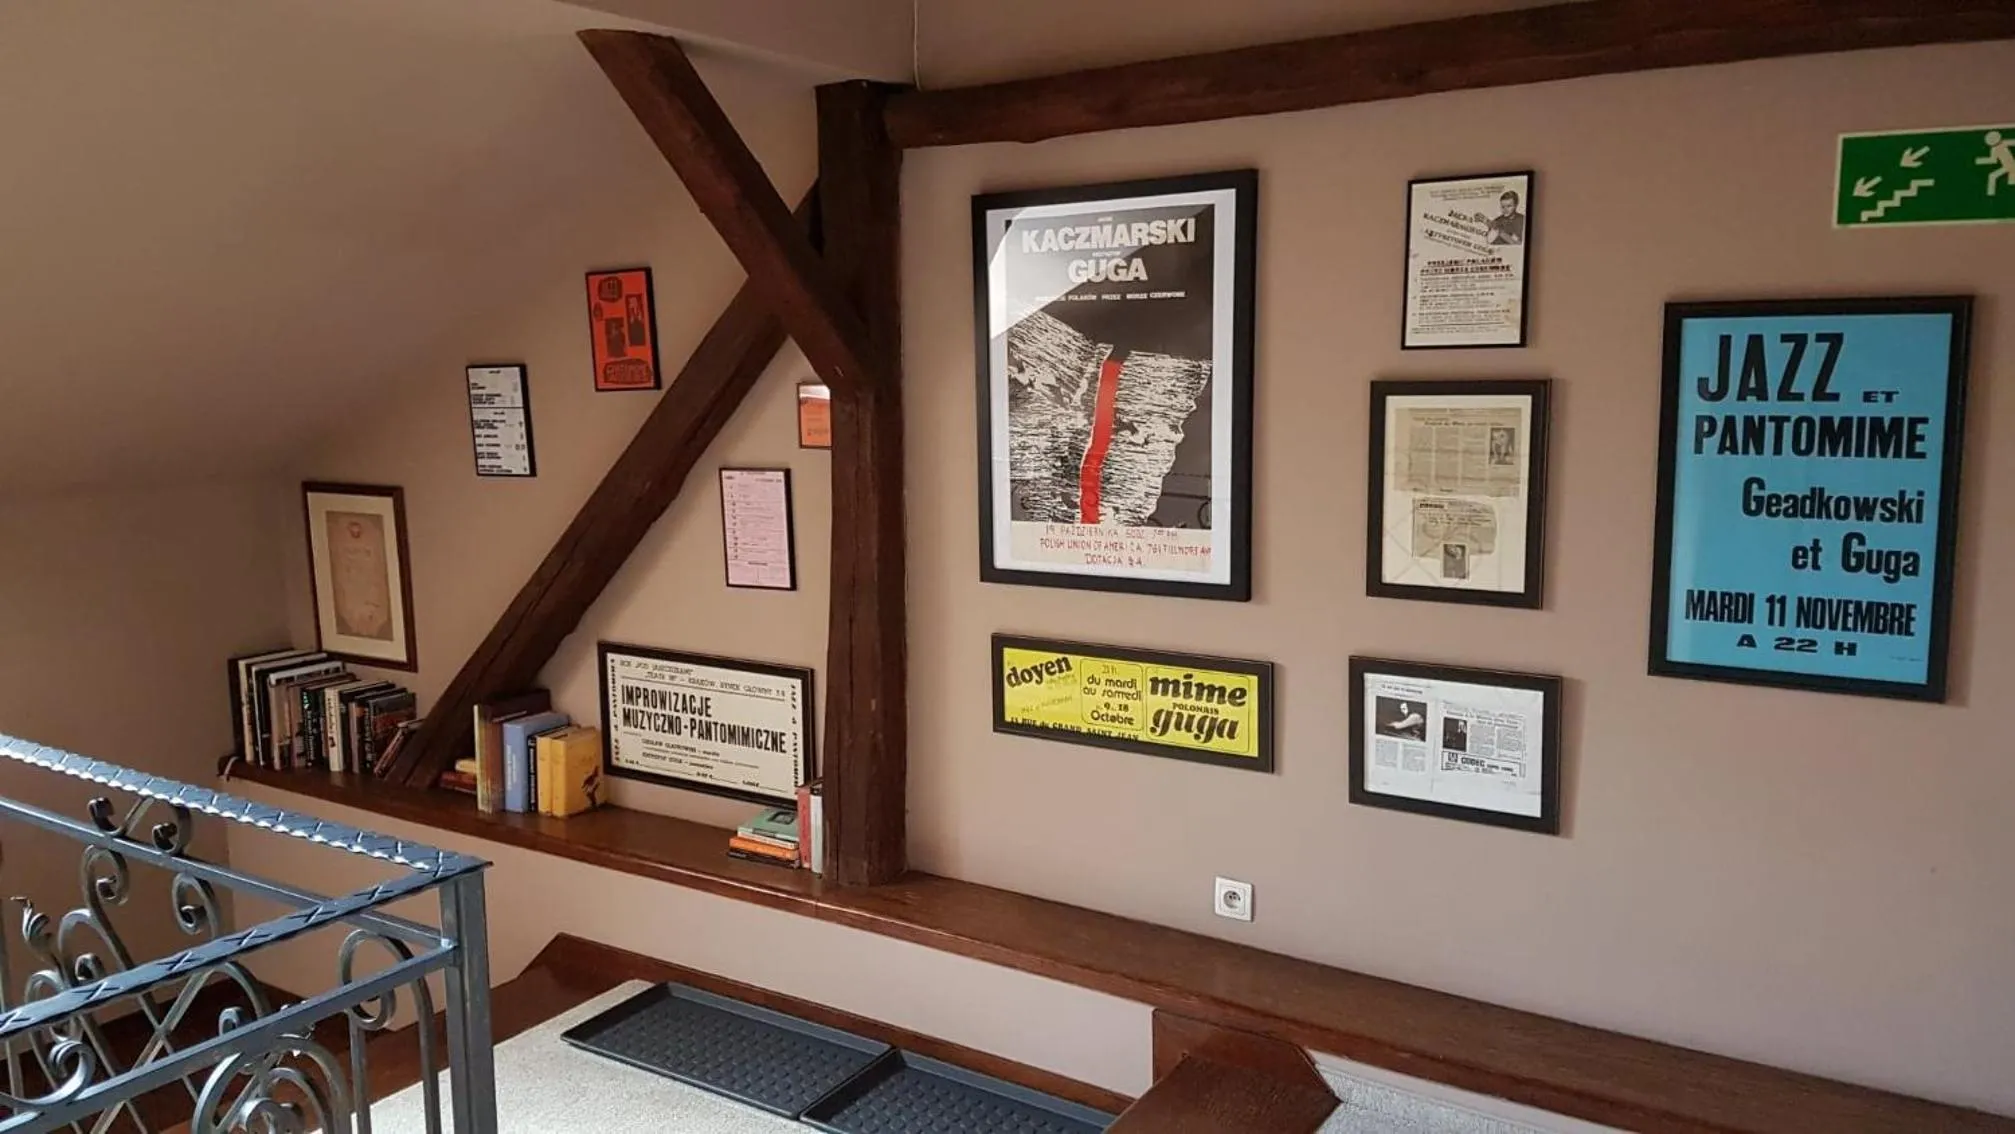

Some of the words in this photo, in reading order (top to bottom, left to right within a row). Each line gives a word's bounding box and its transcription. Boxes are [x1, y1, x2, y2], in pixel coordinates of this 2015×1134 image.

[1022, 218, 1195, 253] KACZMARSKI
[1068, 258, 1148, 283] GUGA
[1697, 332, 1844, 402] JAZZ
[1862, 391, 1900, 403] ET
[1694, 415, 1929, 459] PANTOMIME
[1742, 477, 1925, 524] Geadkowski
[1791, 538, 1823, 571] et
[1841, 532, 1921, 584] Guga
[1685, 589, 1755, 624] MARDI
[1765, 594, 1787, 627] 11
[1796, 596, 1917, 637] NOVEMBRE
[1737, 634, 1757, 648] A
[1774, 637, 1818, 653] 22
[1834, 641, 1857, 656] H
[1006, 656, 1073, 688] doyen
[1087, 674, 1101, 686] du
[1104, 678, 1137, 691] mardi
[621, 684, 713, 718] IMPROWIZACJE
[1083, 687, 1097, 696] au
[1101, 689, 1142, 702] samedi
[1149, 673, 1248, 707] mime
[1090, 709, 1135, 726] Octobre
[1172, 702, 1220, 715] POLONAIS
[1149, 708, 1240, 744] guga
